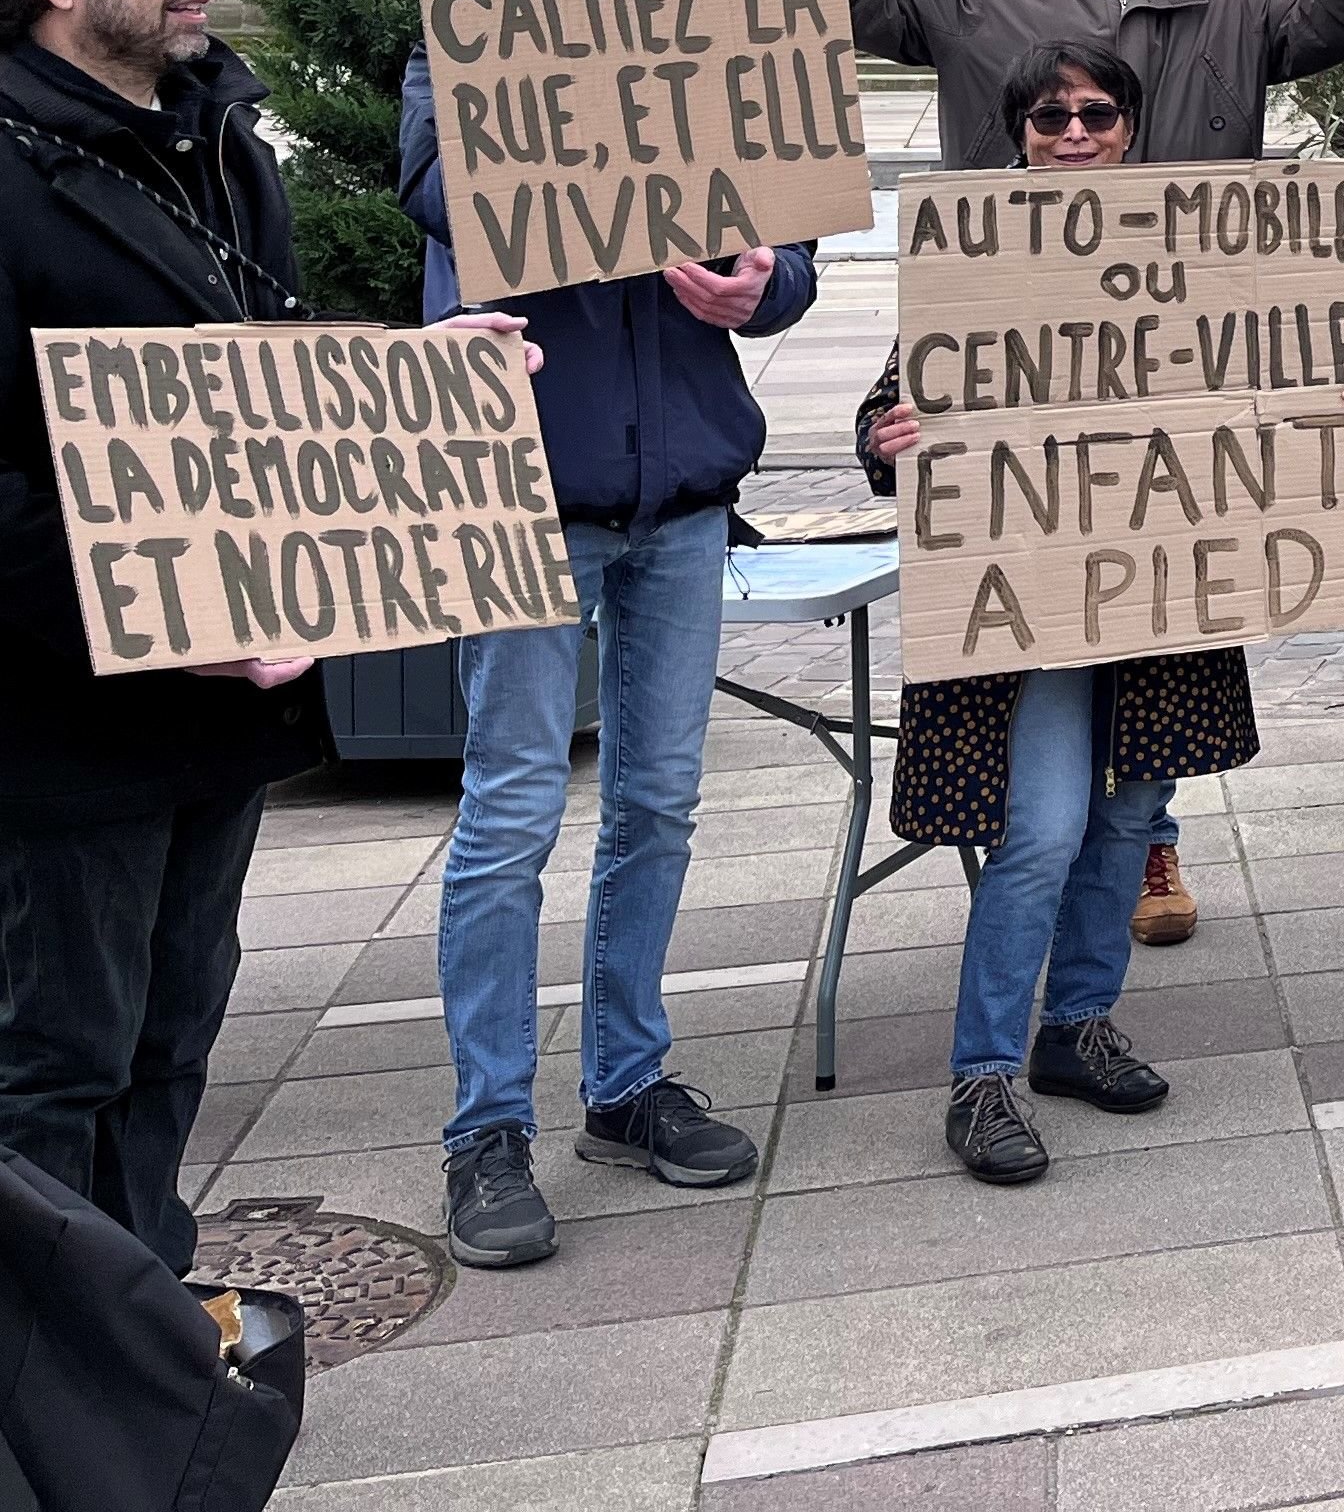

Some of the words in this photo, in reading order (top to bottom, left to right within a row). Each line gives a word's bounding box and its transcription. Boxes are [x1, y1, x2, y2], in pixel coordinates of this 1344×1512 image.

[451, 67, 612, 176] RUE,
[616, 60, 702, 167] ET
[725, 37, 867, 162] ELLE
[472, 167, 765, 288] VIVRA
[45, 333, 518, 434] EMBELLISSONS
[61, 438, 166, 526] LA
[86, 535, 193, 660] ET
[212, 523, 468, 646] NOTRE
[451, 517, 578, 628] RUE
[961, 562, 1036, 658] A
[1084, 527, 1326, 646] PIED
